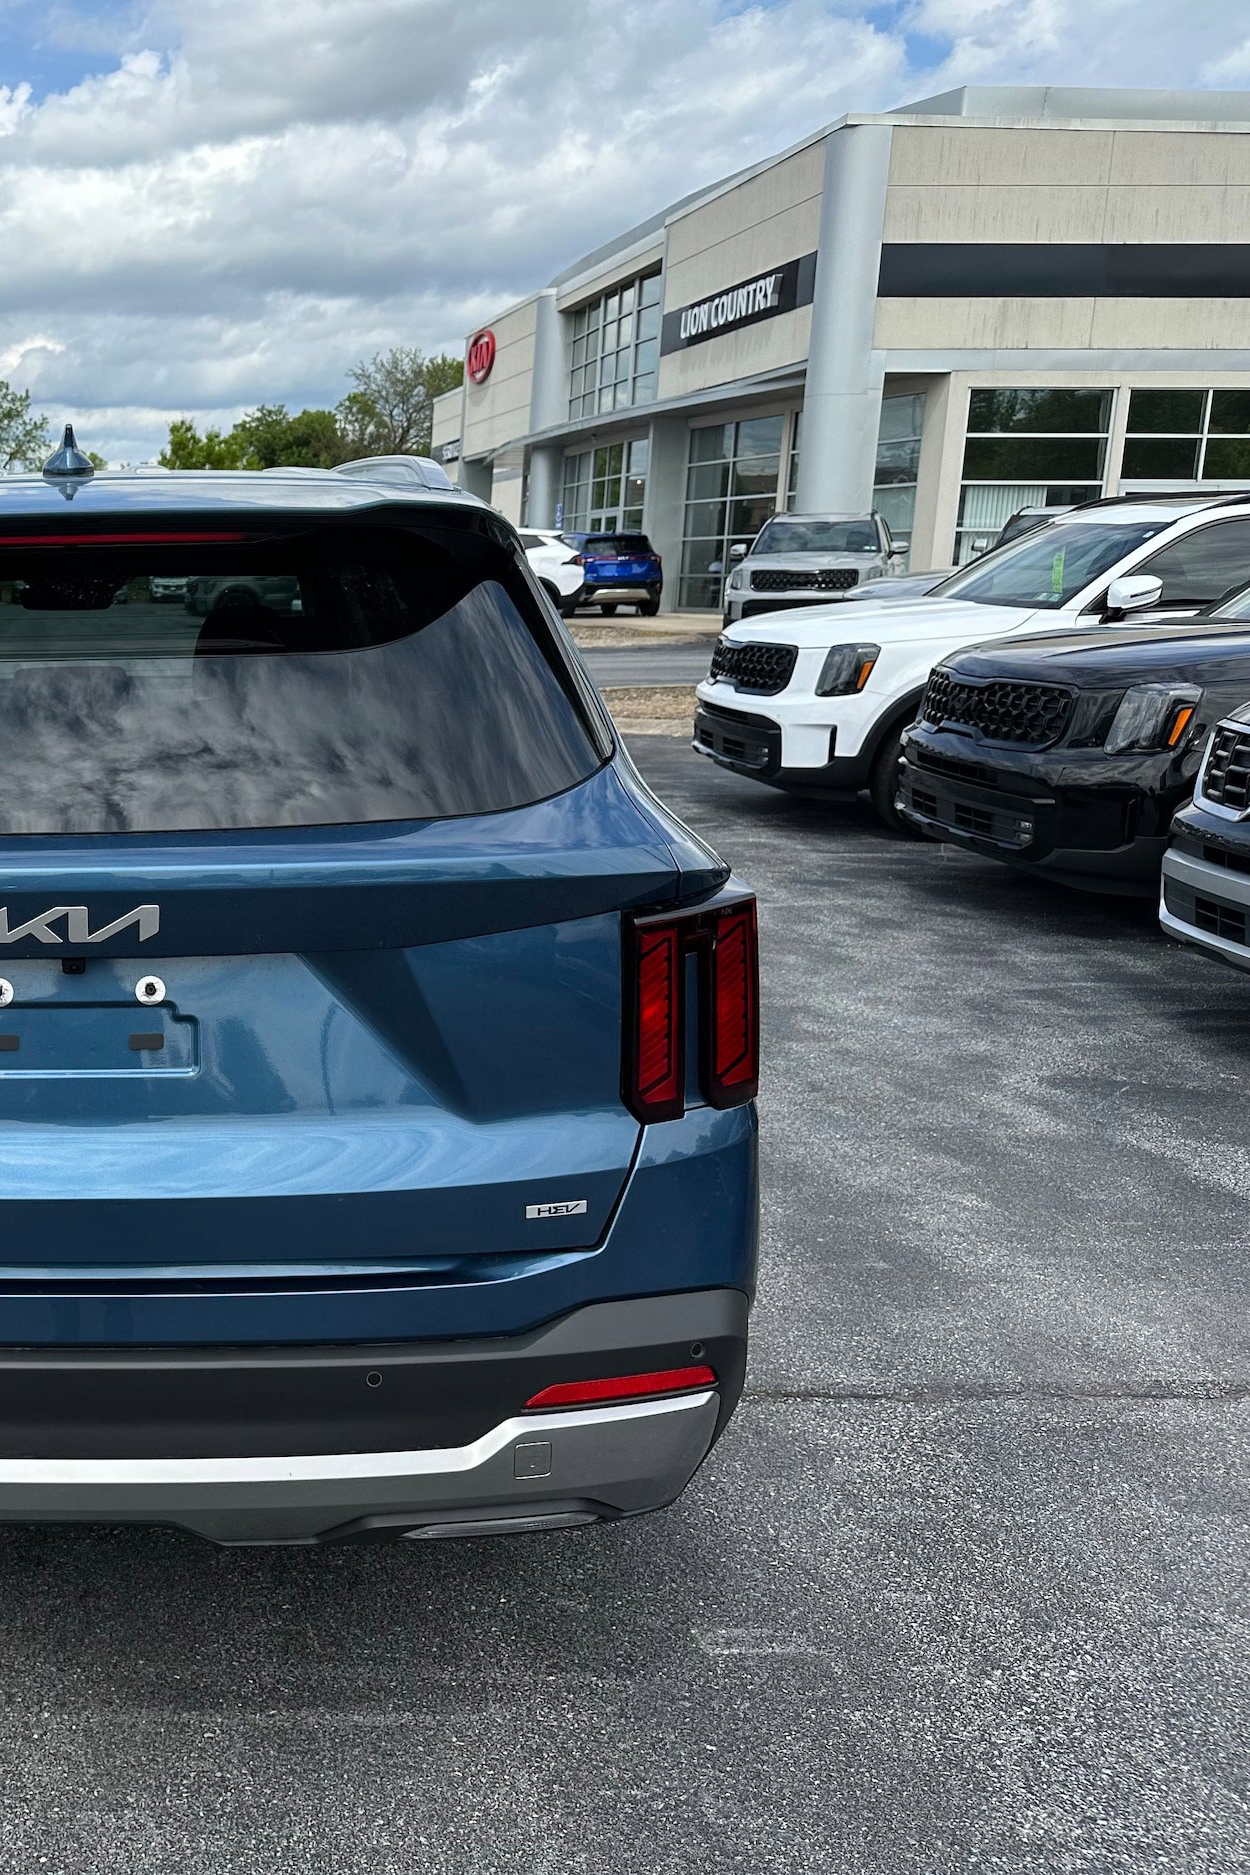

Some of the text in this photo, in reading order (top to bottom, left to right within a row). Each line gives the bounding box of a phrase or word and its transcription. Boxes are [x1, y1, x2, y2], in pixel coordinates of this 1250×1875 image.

[680, 274, 776, 339] LION COUNTRY
[469, 341, 490, 373] KIA
[537, 1202, 580, 1216] HEV
